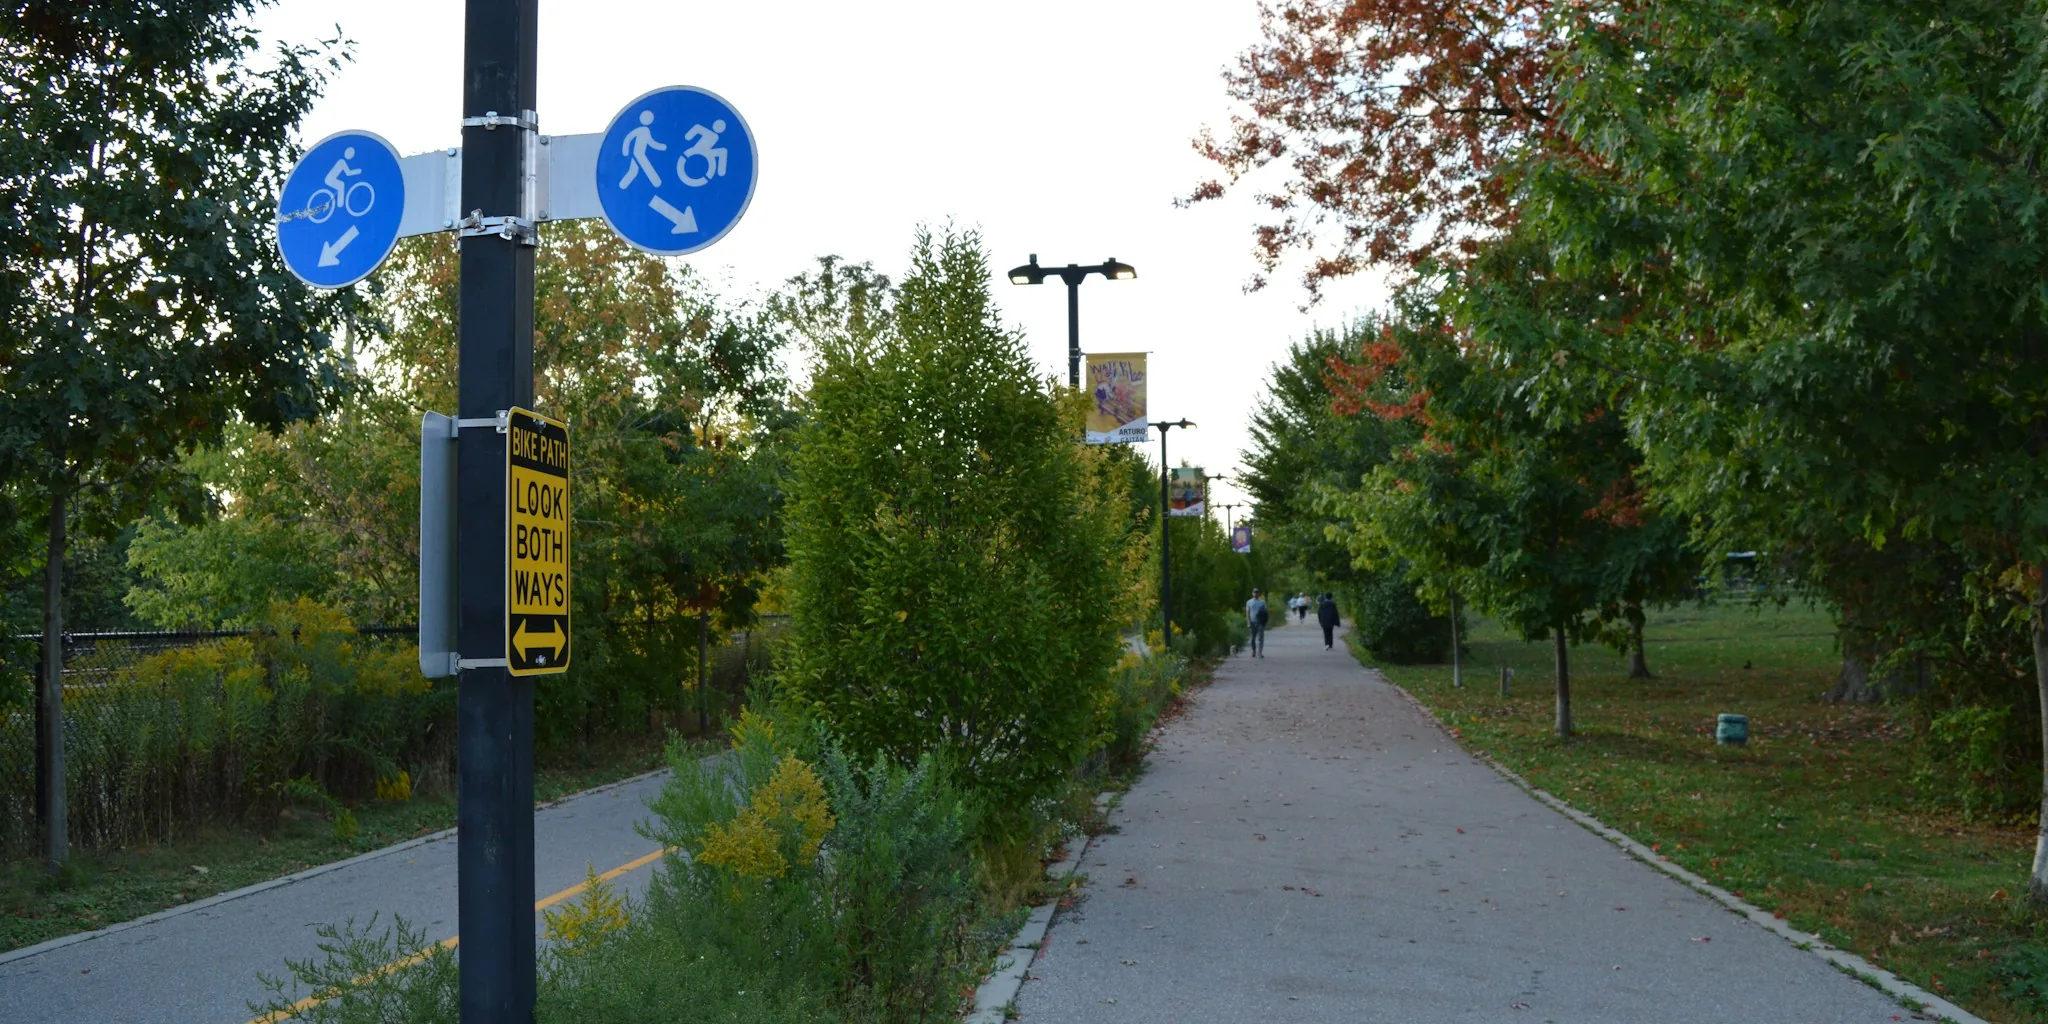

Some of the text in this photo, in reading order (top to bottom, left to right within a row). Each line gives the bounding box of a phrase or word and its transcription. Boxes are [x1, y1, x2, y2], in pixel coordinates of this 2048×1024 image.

[513, 426, 567, 469] BIKE PATH
[1119, 428, 1146, 436] ARTURO
[516, 478, 563, 521] LOOK
[517, 524, 563, 563] BOTH
[515, 570, 564, 607] WAYS
